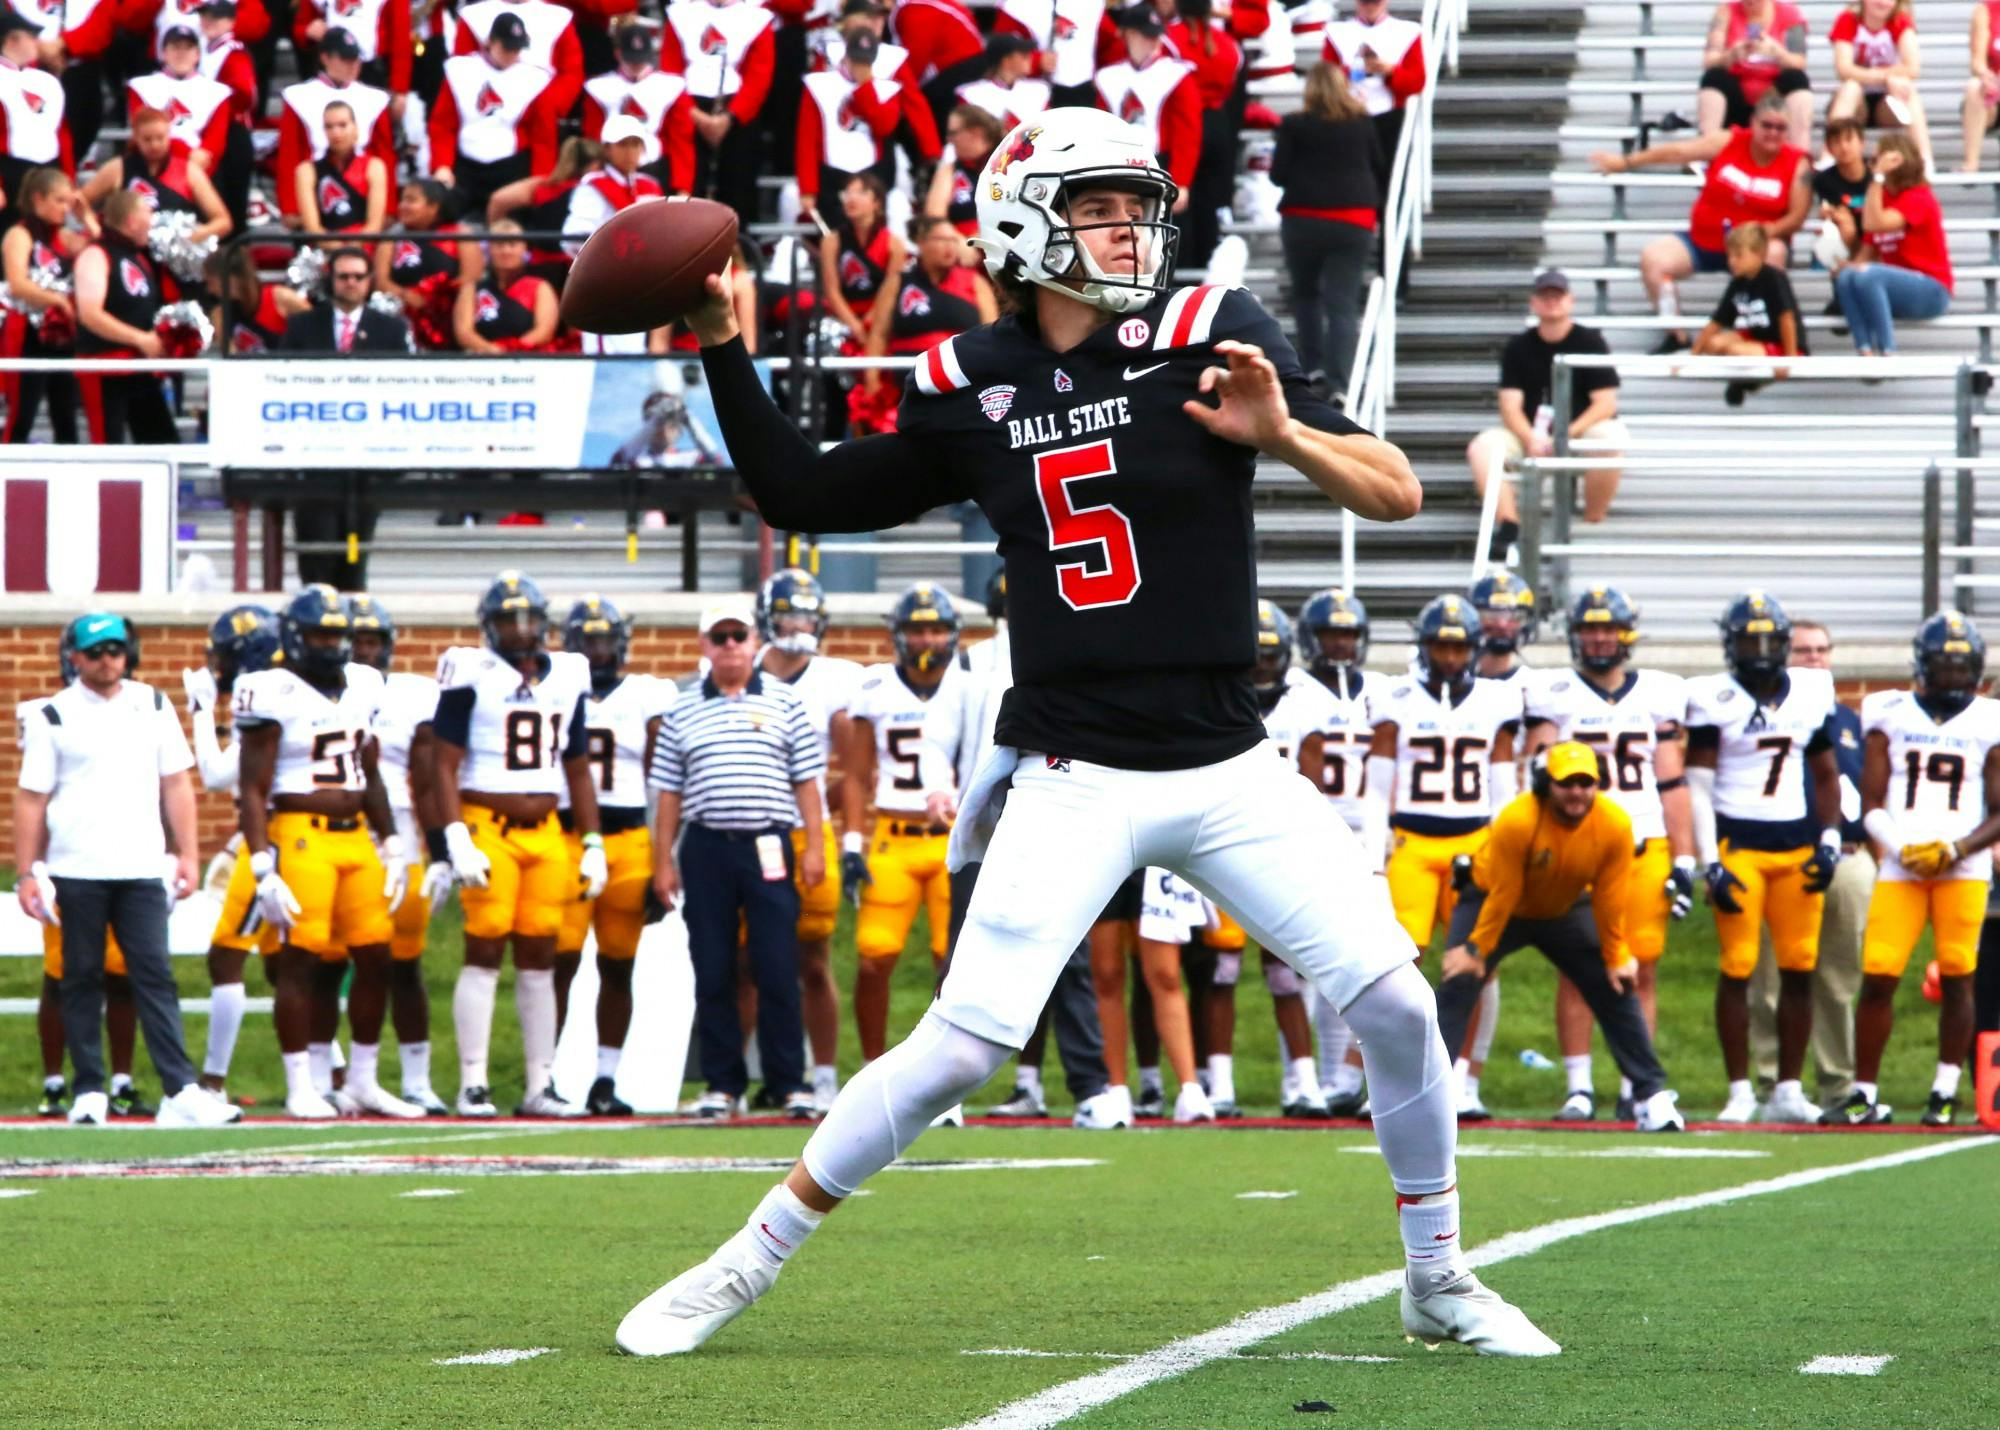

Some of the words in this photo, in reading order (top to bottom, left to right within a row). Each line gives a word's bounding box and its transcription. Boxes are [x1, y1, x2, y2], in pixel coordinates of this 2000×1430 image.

[1122, 322, 1146, 340] TC
[262, 401, 368, 422] GREG
[382, 401, 536, 422] HUBLER
[981, 400, 1013, 413] MAC
[1007, 413, 1063, 449] BALL
[1067, 396, 1132, 437] STATE
[1033, 438, 1142, 611] 5
[506, 710, 563, 771] 81
[886, 727, 924, 790] 5
[1408, 735, 1487, 803] 26
[1756, 736, 1792, 796] 7
[1905, 749, 1965, 811] 19
